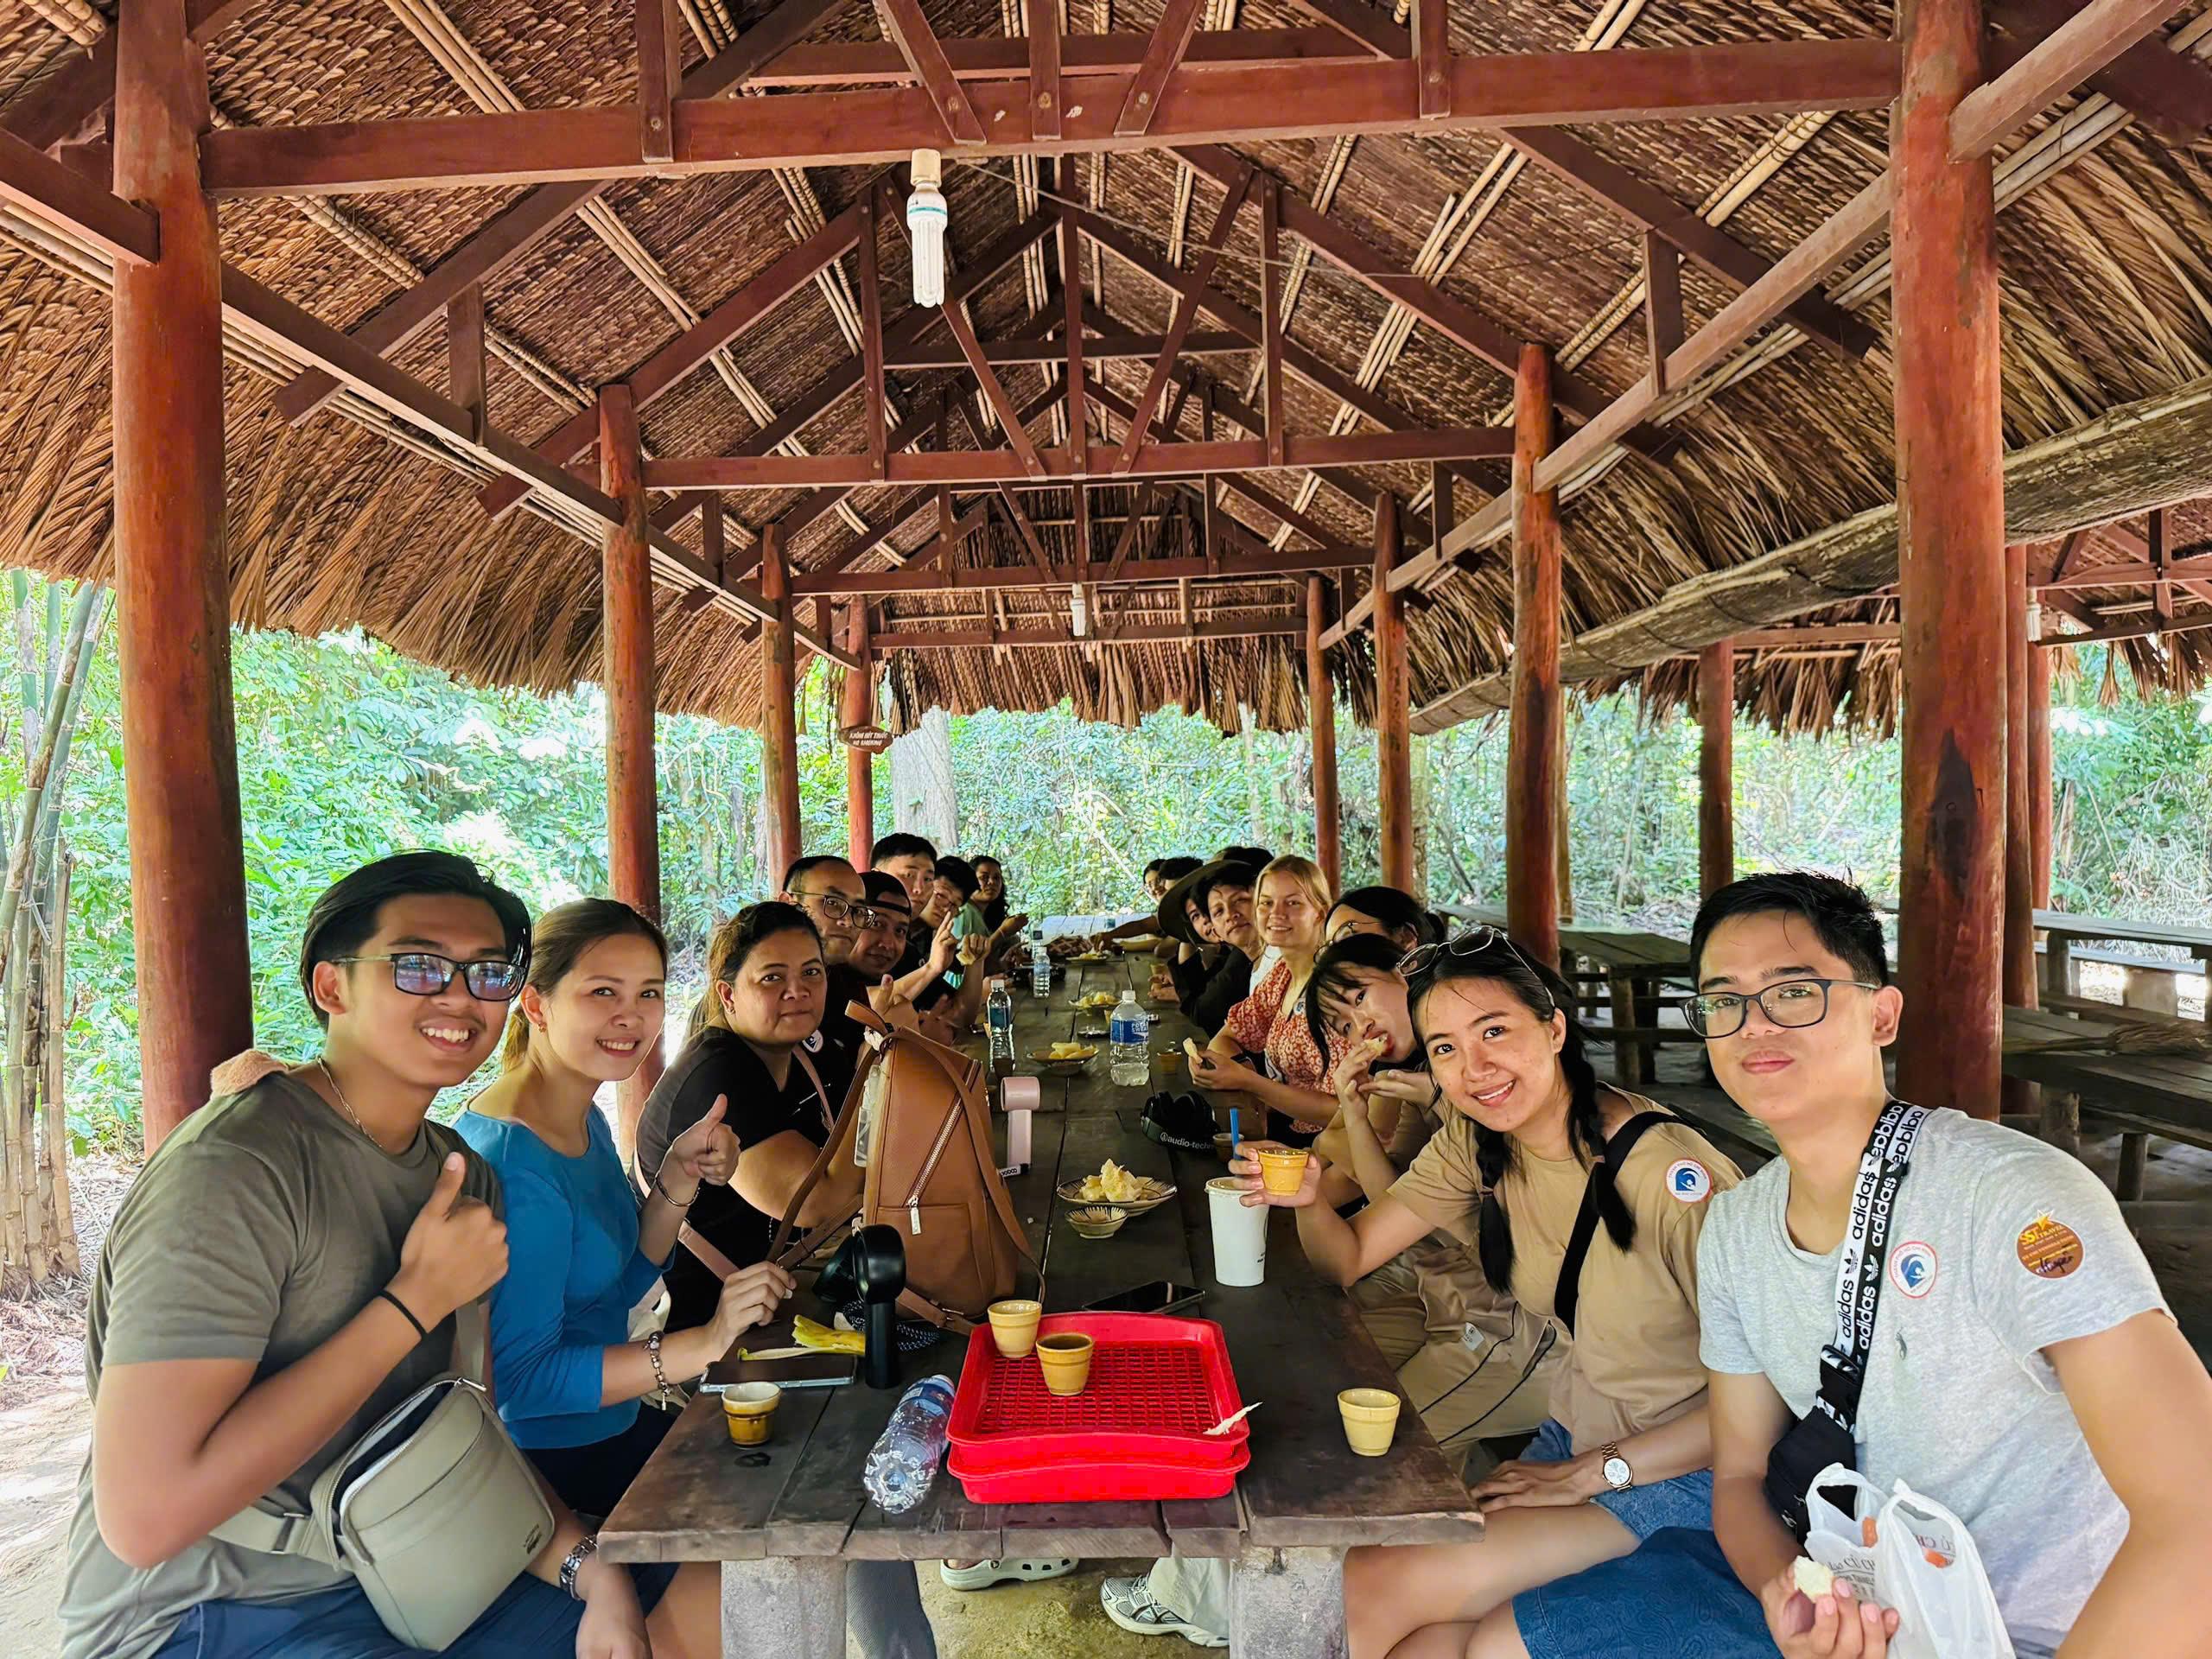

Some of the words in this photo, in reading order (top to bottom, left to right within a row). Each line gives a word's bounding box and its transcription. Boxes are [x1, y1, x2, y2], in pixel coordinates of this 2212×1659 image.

[1853, 1172, 1876, 1240] adidas
[1871, 1177, 1897, 1247] adidas
[1837, 1279, 1854, 1338] adidas
[1855, 1286, 1877, 1350] adidas
